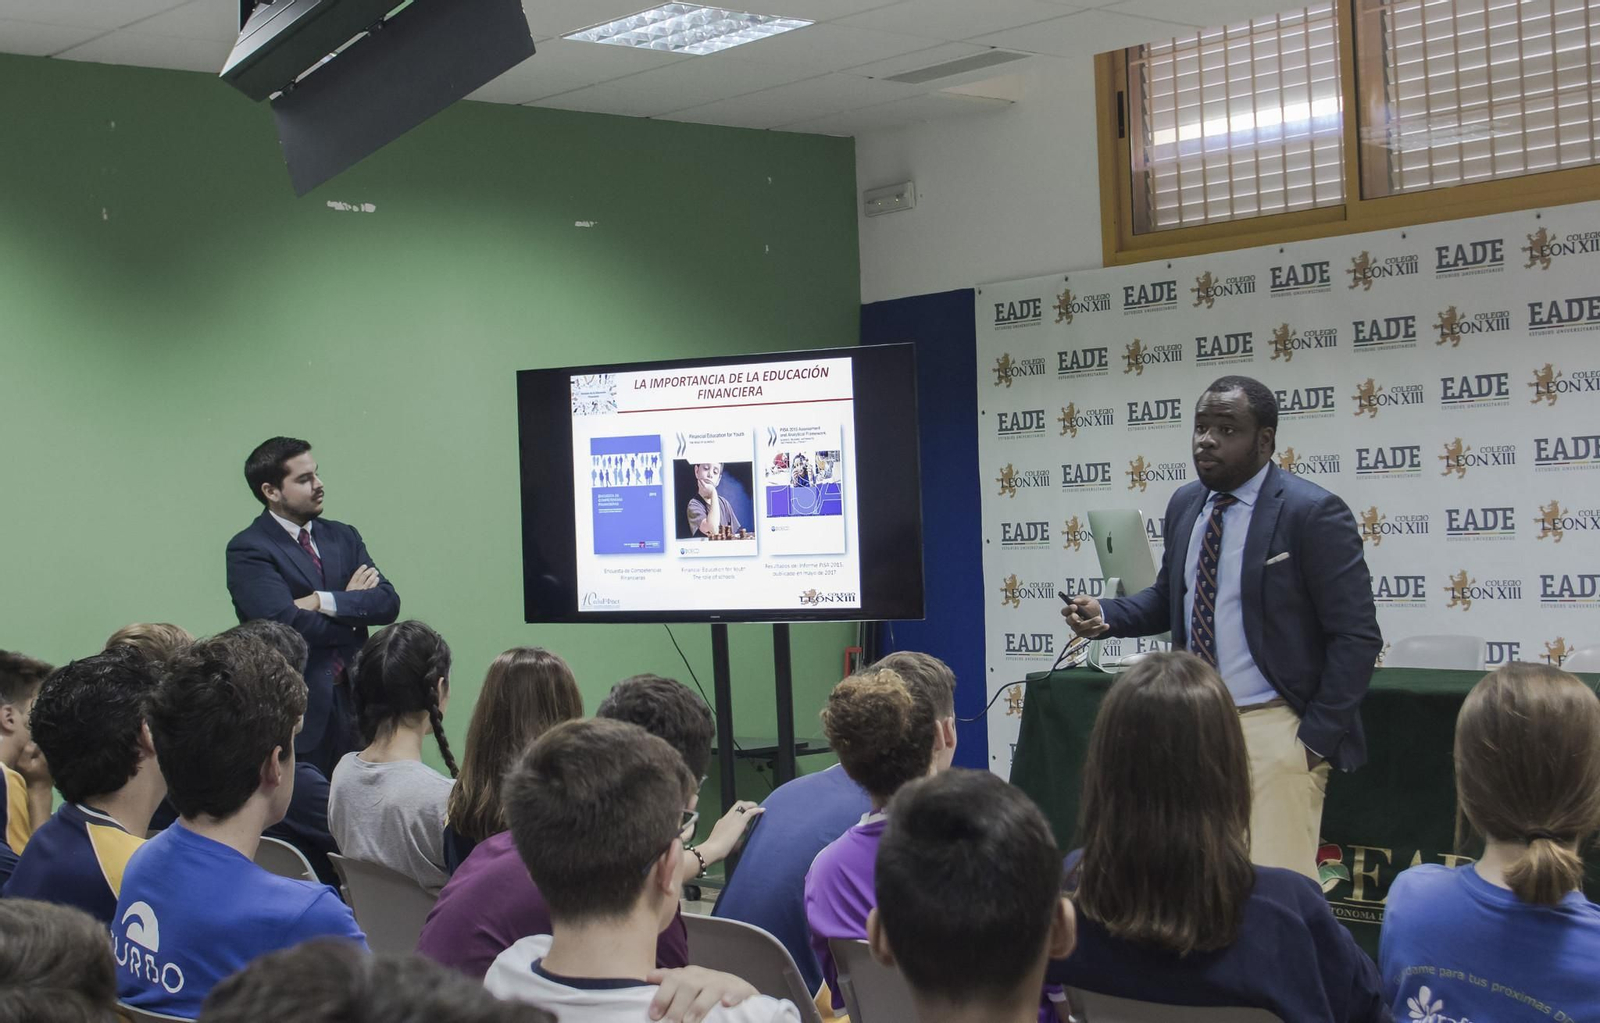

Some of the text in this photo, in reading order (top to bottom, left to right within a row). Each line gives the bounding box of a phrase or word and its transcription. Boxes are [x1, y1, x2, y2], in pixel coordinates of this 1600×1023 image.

[1436, 239, 1503, 269] EADE
[1577, 238, 1600, 254] XII
[1270, 261, 1331, 288] EADE
[1396, 262, 1418, 275] XIII
[1123, 280, 1177, 307] EADE
[1235, 282, 1256, 294] XIII
[995, 298, 1042, 322] EADE
[1528, 296, 1600, 326] EADE
[1352, 316, 1416, 343] EADE
[1486, 318, 1510, 331] XIII
[1196, 332, 1253, 358] EADE
[1314, 336, 1337, 348] XIII
[1058, 348, 1108, 371] EADE
[1162, 351, 1182, 362] XIII
[634, 366, 830, 390] LA IMPORTANCIA DE LA EDUCACIÓN
[1572, 371, 1600, 380] COLEG
[698, 386, 763, 400] FINANCIERA
[1441, 373, 1508, 400] EADE
[1584, 379, 1600, 392] XI
[1274, 387, 1334, 412] EADE
[1401, 392, 1424, 404] XIII
[1095, 414, 1114, 426] XIII
[1127, 399, 1181, 423] EADE
[998, 410, 1045, 432] EADE
[1316, 462, 1340, 474] XIII
[1356, 446, 1420, 471] EADE
[1492, 452, 1516, 465] XIII
[1032, 476, 1050, 487] XIII
[1062, 463, 1111, 484] EADE
[1167, 469, 1186, 480] XIII
[1406, 521, 1429, 534] XIII
[1446, 508, 1515, 531] EADE
[1001, 522, 1049, 542] EADE
[1036, 588, 1054, 599] XIII
[1066, 578, 1103, 597] EAD
[1497, 587, 1522, 599] XIII
[1540, 575, 1600, 598] EAD
[1005, 634, 1053, 653] EADE
[1102, 646, 1121, 656] XIII
[1486, 642, 1520, 663] DE
[110, 930, 184, 993] URBO
[1439, 968, 1464, 980] para
[1469, 974, 1488, 987] tus
